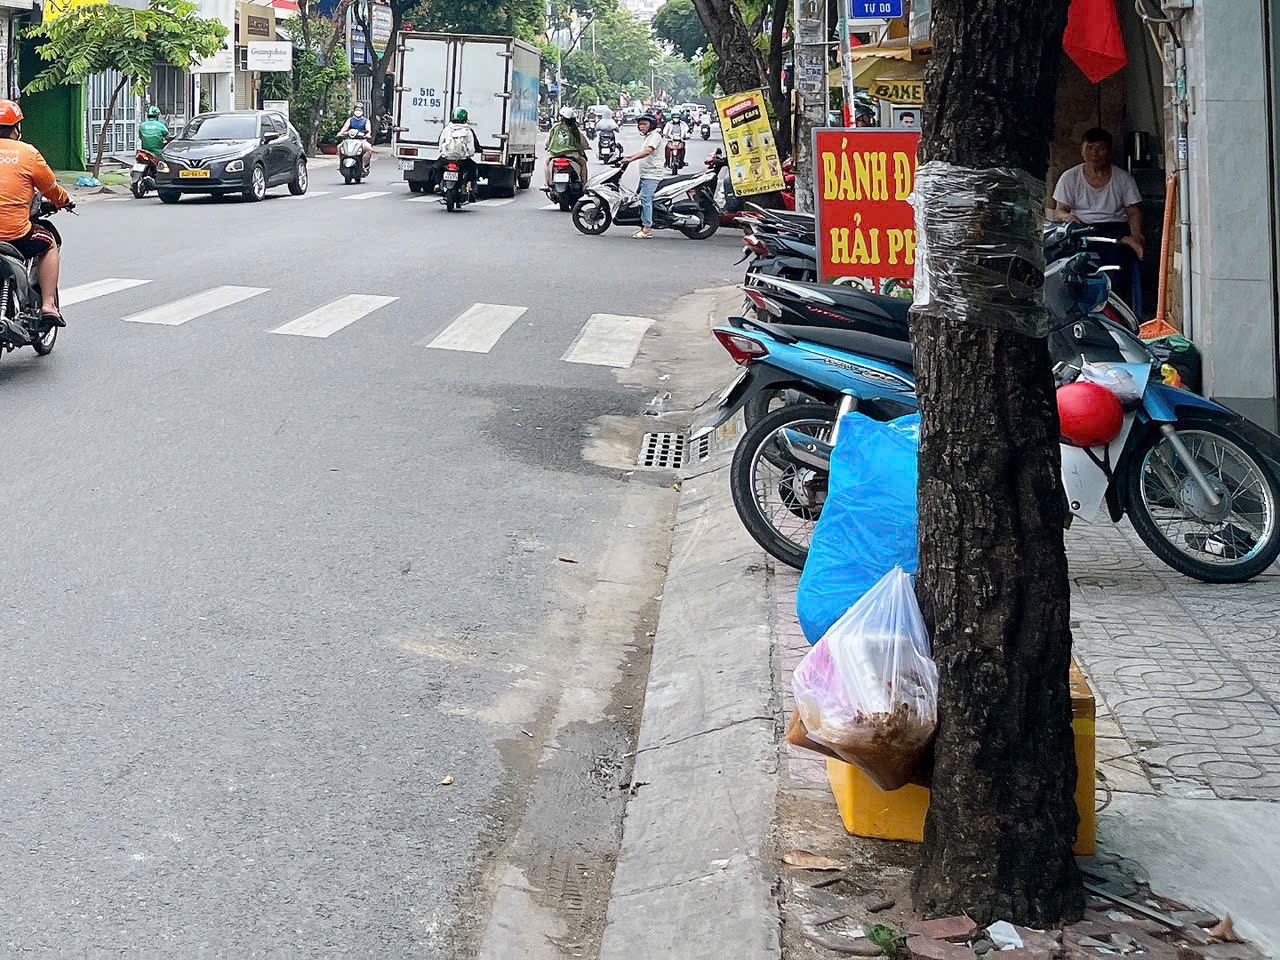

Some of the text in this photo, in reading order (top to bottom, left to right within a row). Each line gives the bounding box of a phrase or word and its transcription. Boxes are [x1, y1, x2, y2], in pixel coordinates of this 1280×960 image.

[864, 3, 876, 15] TỰ
[822, 137, 919, 201] BÁNH Đ
[830, 212, 881, 264] HẢI
